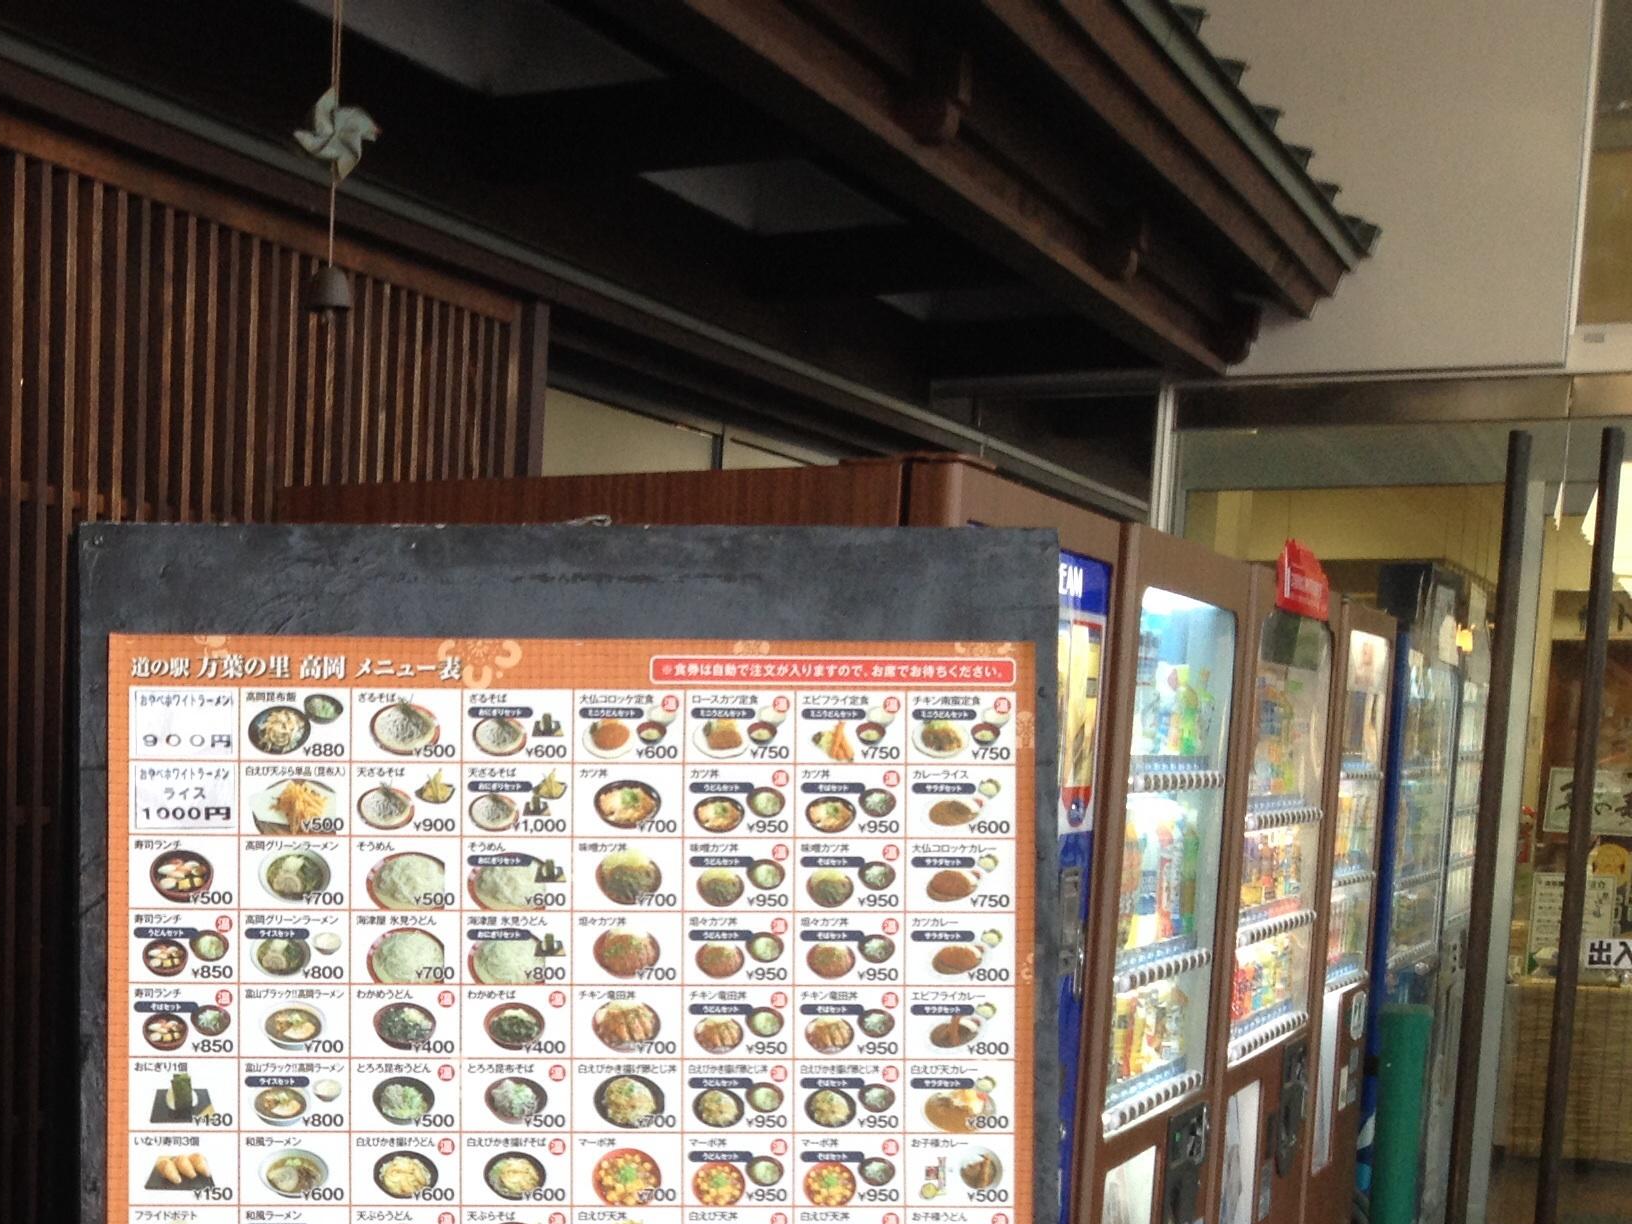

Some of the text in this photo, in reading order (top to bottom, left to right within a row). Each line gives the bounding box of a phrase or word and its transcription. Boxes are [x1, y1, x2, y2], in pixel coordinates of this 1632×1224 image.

[131, 655, 462, 681] 道の駅 万葉の里 高岡 メニュー表
[246, 692, 296, 703] 高岡昆布飯
[357, 692, 395, 703] ざるそば
[469, 692, 507, 704] ざるそば
[579, 694, 654, 705] 大仏コロッケ定食
[691, 695, 758, 705] ロースカツ定食
[802, 695, 869, 705] エビフライ定食
[302, 744, 344, 757] ¥880
[414, 744, 455, 757] ¥500
[524, 744, 566, 757] ¥600
[636, 746, 677, 759] ¥600
[747, 746, 788, 759] ¥750
[968, 746, 1010, 759] ¥750
[356, 767, 405, 778] 天ざるそば
[579, 768, 609, 779] カツ丼
[912, 769, 968, 780] カレーライス
[164, 787, 206, 800] ライス
[142, 806, 231, 820] 1000円
[302, 818, 344, 831] ¥500
[413, 818, 455, 831] ¥900
[513, 818, 566, 831] ¥1,000
[635, 820, 677, 833] ¥700
[747, 820, 788, 833] ¥950
[968, 820, 1010, 833] ¥600
[134, 839, 182, 851] 寿司ランチ
[245, 841, 339, 852] 高岡グリーンラーメン
[356, 841, 395, 852] そうめん
[912, 843, 997, 854] 大仏コロッケカレー
[192, 892, 233, 905] ¥500
[302, 892, 344, 905] ¥700
[524, 892, 566, 905] ¥600
[747, 894, 788, 907] ¥950
[968, 894, 1009, 907] ¥750
[911, 917, 959, 927] カツカレー
[192, 966, 233, 978] ¥850
[302, 966, 344, 978] ¥800
[413, 966, 455, 978] ¥700
[356, 989, 413, 1000] わかめうどん
[467, 989, 516, 1000] わかめそば
[911, 990, 986, 1001] エビフライカレー
[192, 1040, 233, 1054] ¥850
[302, 1040, 344, 1054] ¥700
[413, 1040, 454, 1054] ¥400
[635, 1042, 676, 1054] ¥700
[967, 1042, 1009, 1054] ¥800
[134, 1061, 188, 1073] おにぎり1個
[356, 1063, 432, 1074] とろろ昆布うどん
[467, 1063, 534, 1074] とろろ昆布そば
[910, 1064, 978, 1075] 白えび天カレー
[192, 1114, 233, 1127] ¥130
[524, 1114, 565, 1127] ¥500
[967, 1116, 1009, 1128] ¥800
[133, 1135, 200, 1147] いなり寿司3個
[246, 1136, 302, 1147] 和風ラーメン
[911, 1138, 968, 1149] お子様カレー
[192, 1188, 233, 1200] ¥150
[302, 1188, 344, 1200] ¥600
[635, 1189, 676, 1202] ¥700
[967, 1189, 1008, 1202] ¥500
[134, 1210, 198, 1221] フライドポテト
[356, 1210, 413, 1221] 天ぷらうどん
[467, 1211, 516, 1222] 天ぷらそば
[578, 1211, 627, 1222] 白えび天丼
[911, 1212, 968, 1223] お子様うどん
